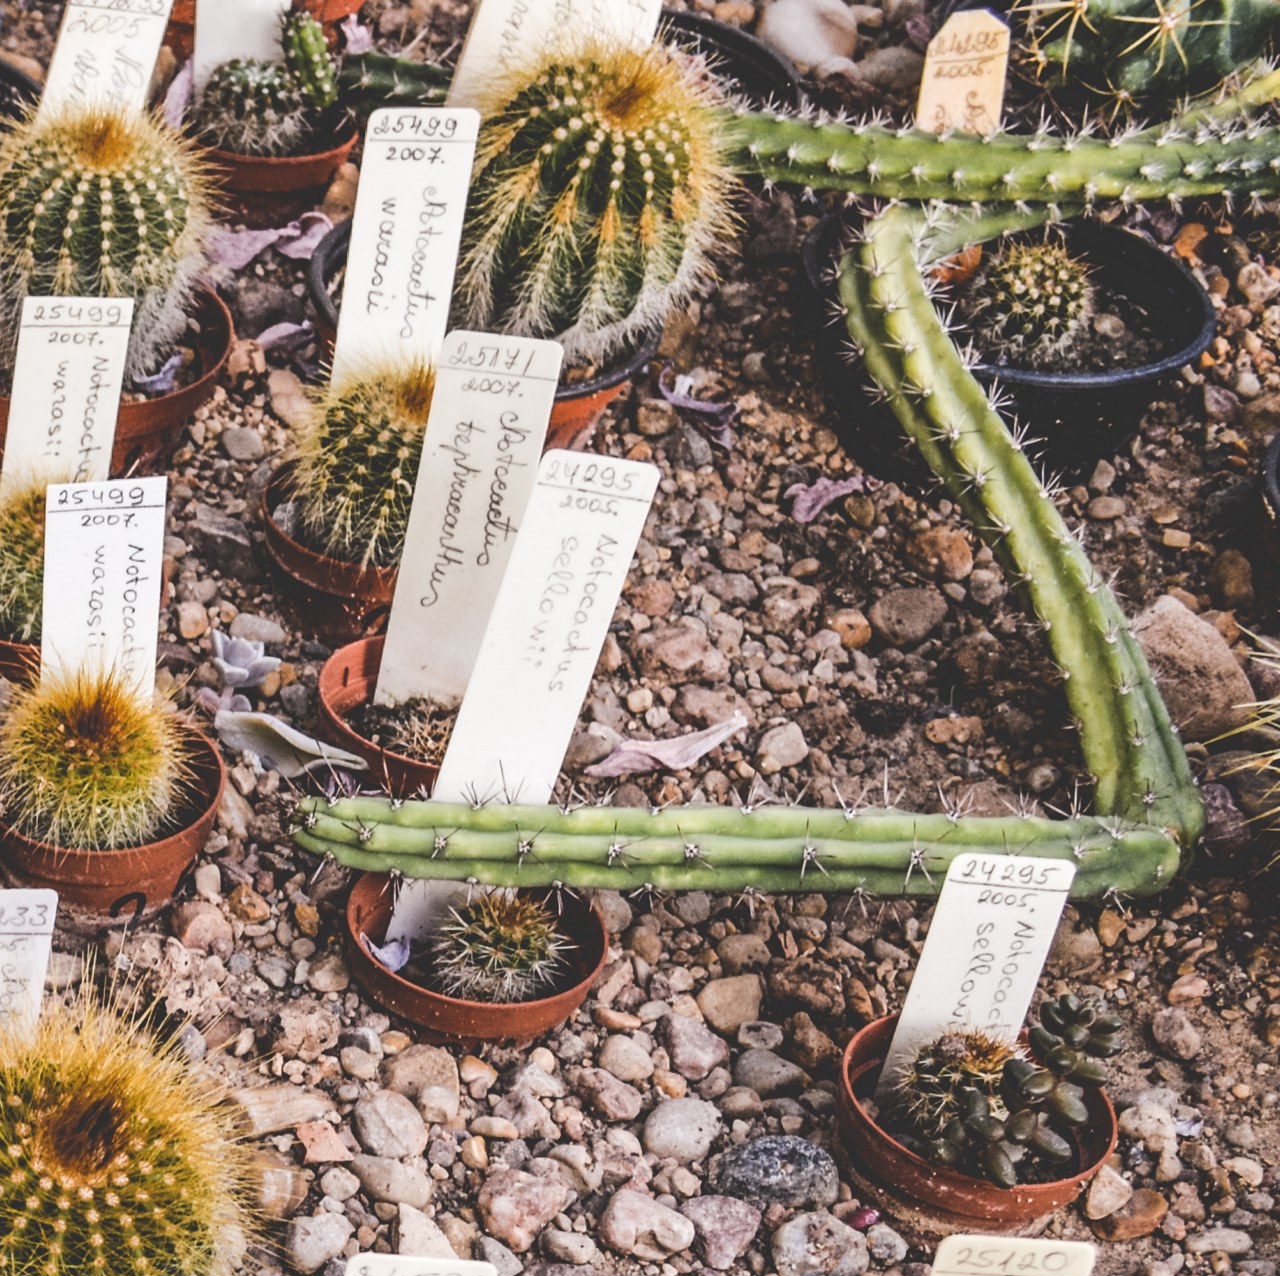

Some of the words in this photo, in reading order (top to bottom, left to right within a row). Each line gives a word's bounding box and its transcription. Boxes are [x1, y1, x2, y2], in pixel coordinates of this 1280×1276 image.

[373, 114, 458, 139] 25499
[364, 196, 396, 317] warasii
[33, 303, 123, 326] 25499
[42, 358, 70, 458] warasii
[75, 354, 110, 478] Notocactu
[57, 485, 145, 507] 25499
[545, 455, 640, 492] 24295
[85, 544, 107, 650] warasii
[546, 532, 620, 694] Notocactus
[959, 858, 1060, 886] 24295
[946, 920, 995, 1028] sellowi
[986, 920, 1037, 1037] Notocact
[955, 1246, 1069, 1274] 25120
